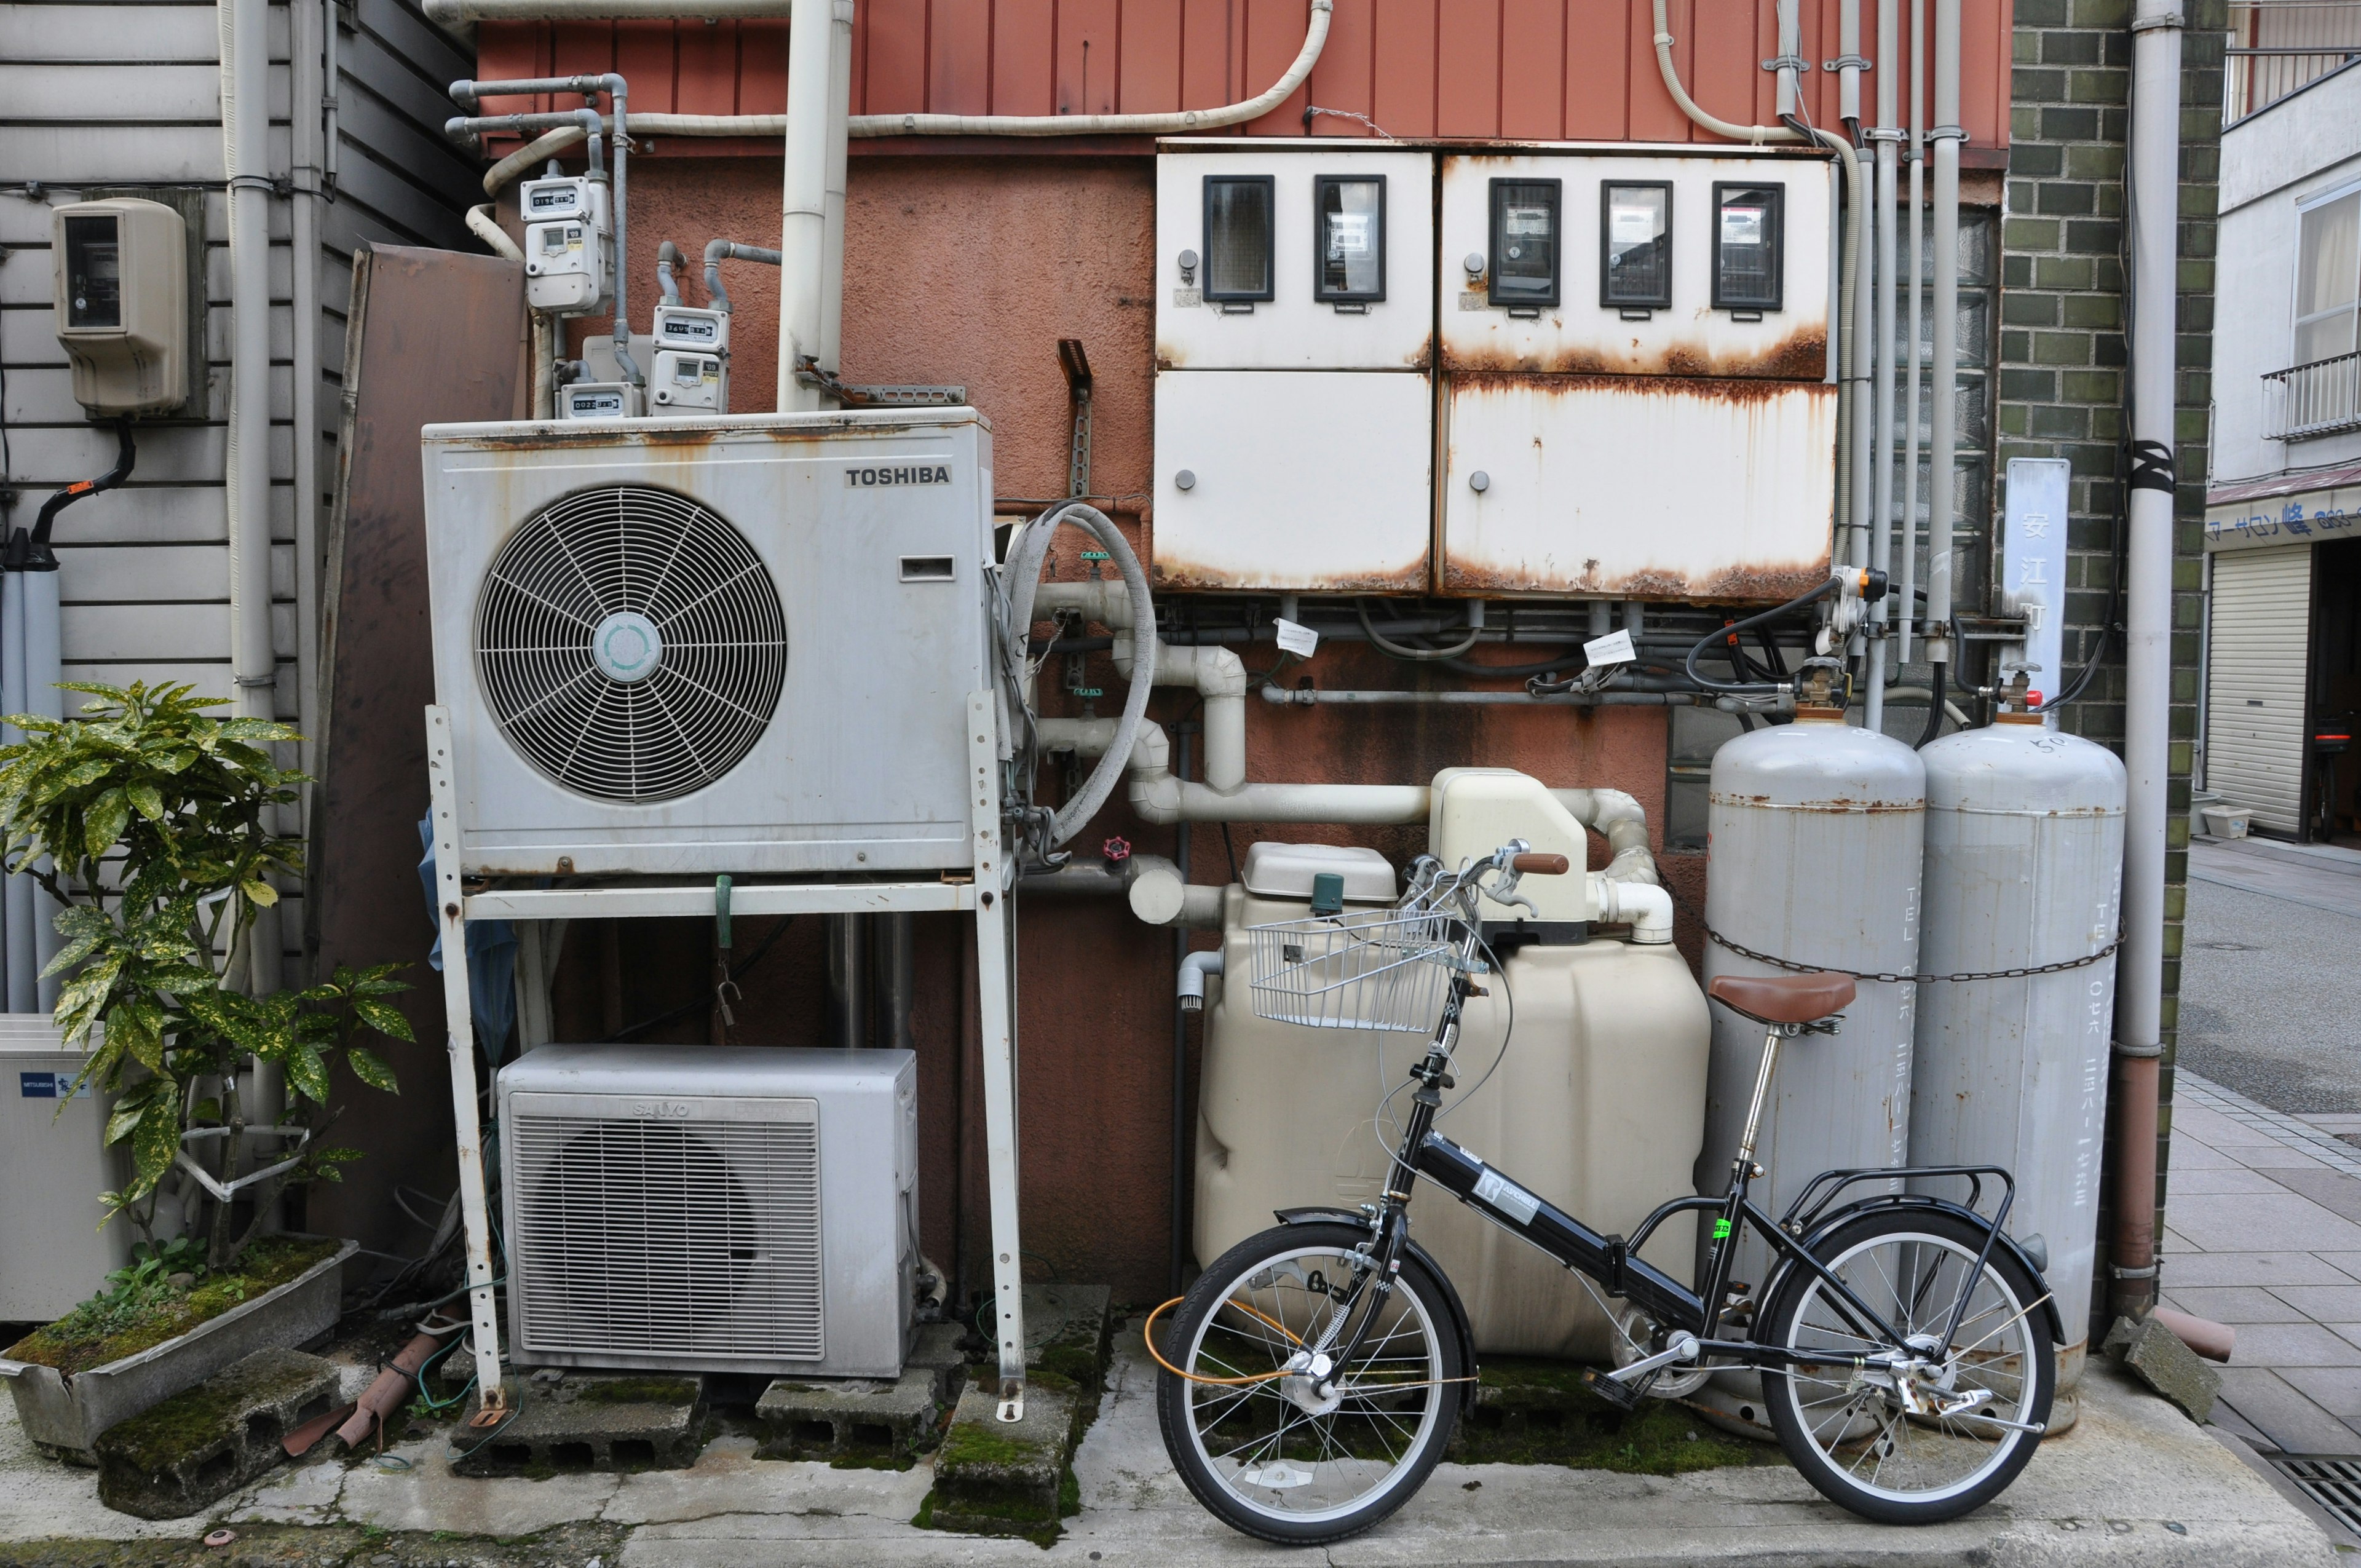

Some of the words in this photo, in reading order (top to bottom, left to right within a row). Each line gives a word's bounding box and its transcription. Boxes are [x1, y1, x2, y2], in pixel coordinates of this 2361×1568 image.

[846, 467, 949, 486] TOSHIBA
[2327, 507, 2361, 527] 63-
[2020, 511, 2049, 631] 安江町
[1904, 887, 1915, 941] TEL
